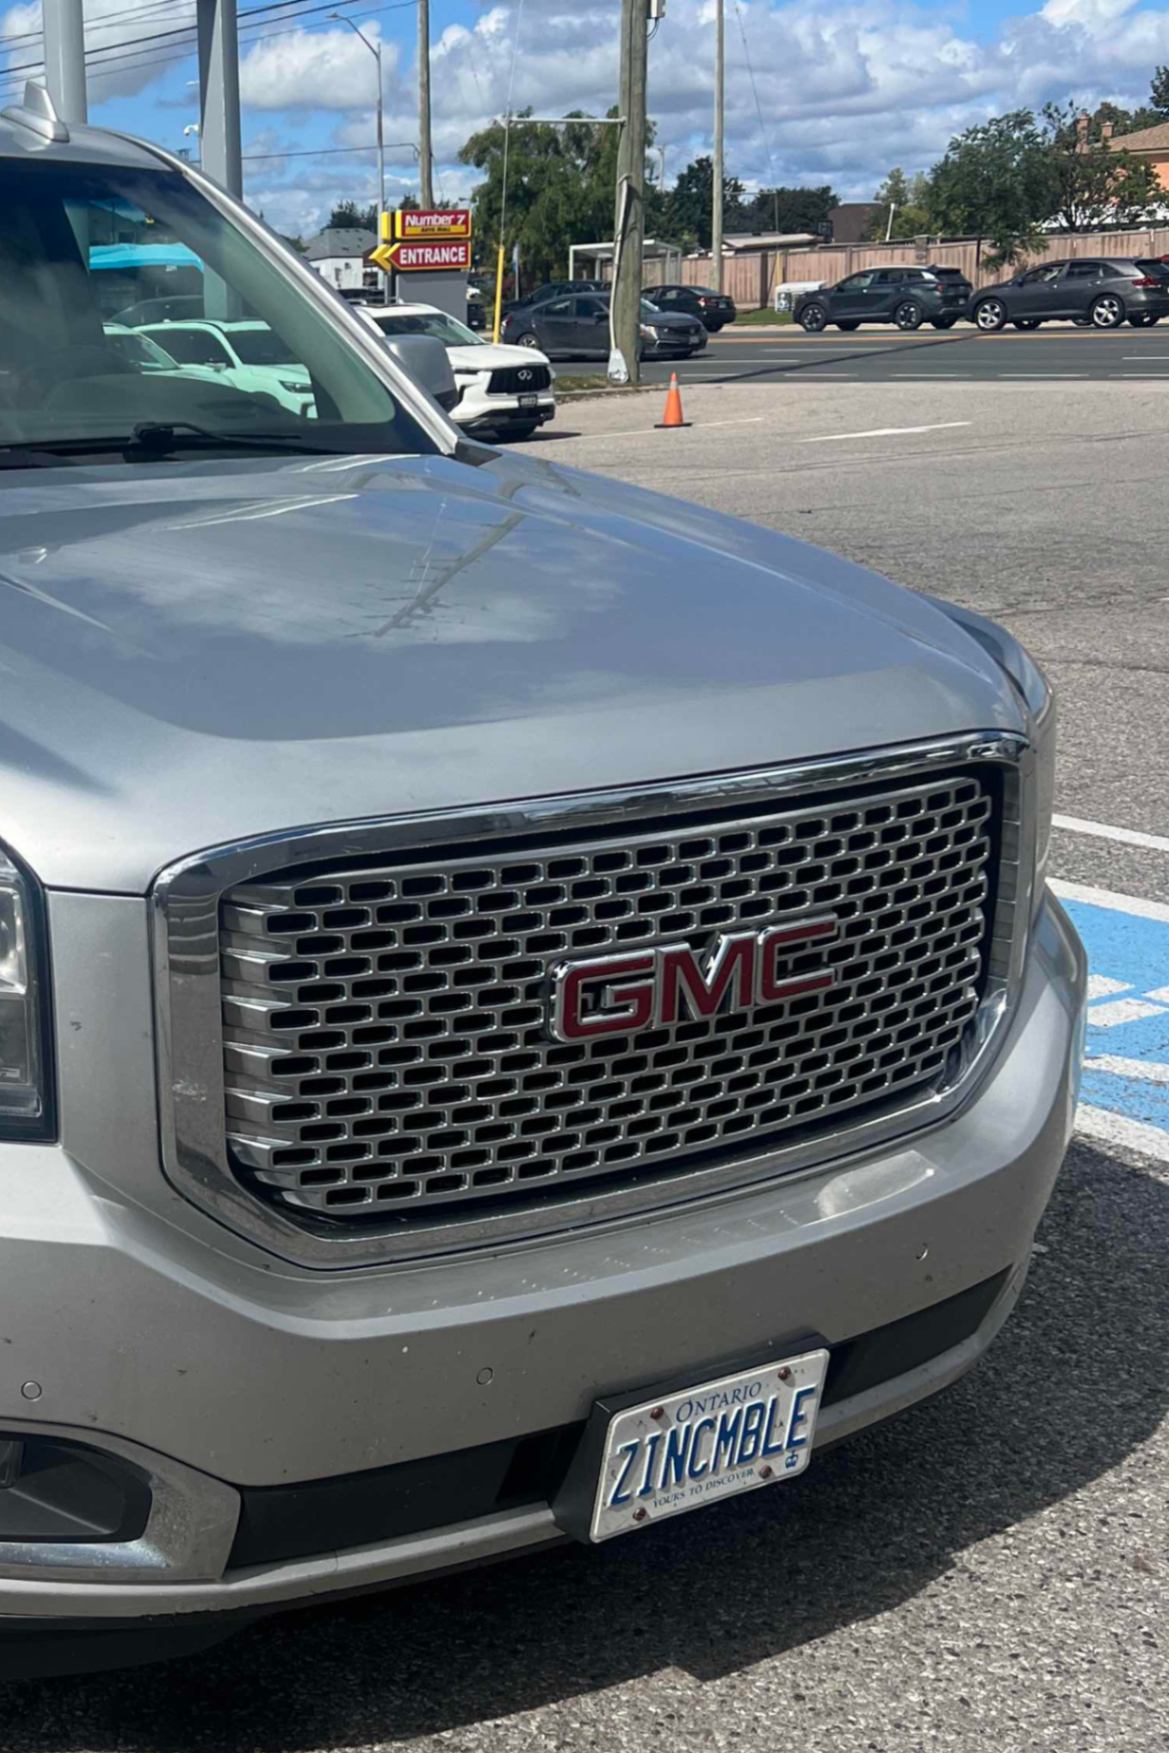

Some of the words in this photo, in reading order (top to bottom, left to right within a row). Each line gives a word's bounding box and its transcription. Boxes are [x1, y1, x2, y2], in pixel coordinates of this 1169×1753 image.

[405, 214, 455, 226] Number
[457, 214, 466, 225] 7
[400, 246, 466, 265] ENTRANCE
[554, 912, 838, 1043] GMC
[607, 1384, 817, 1508] ZINCMBLE
[652, 1491, 686, 1508] YOURS
[690, 1484, 703, 1496] TO
[705, 1468, 754, 1491] DISCOVER
